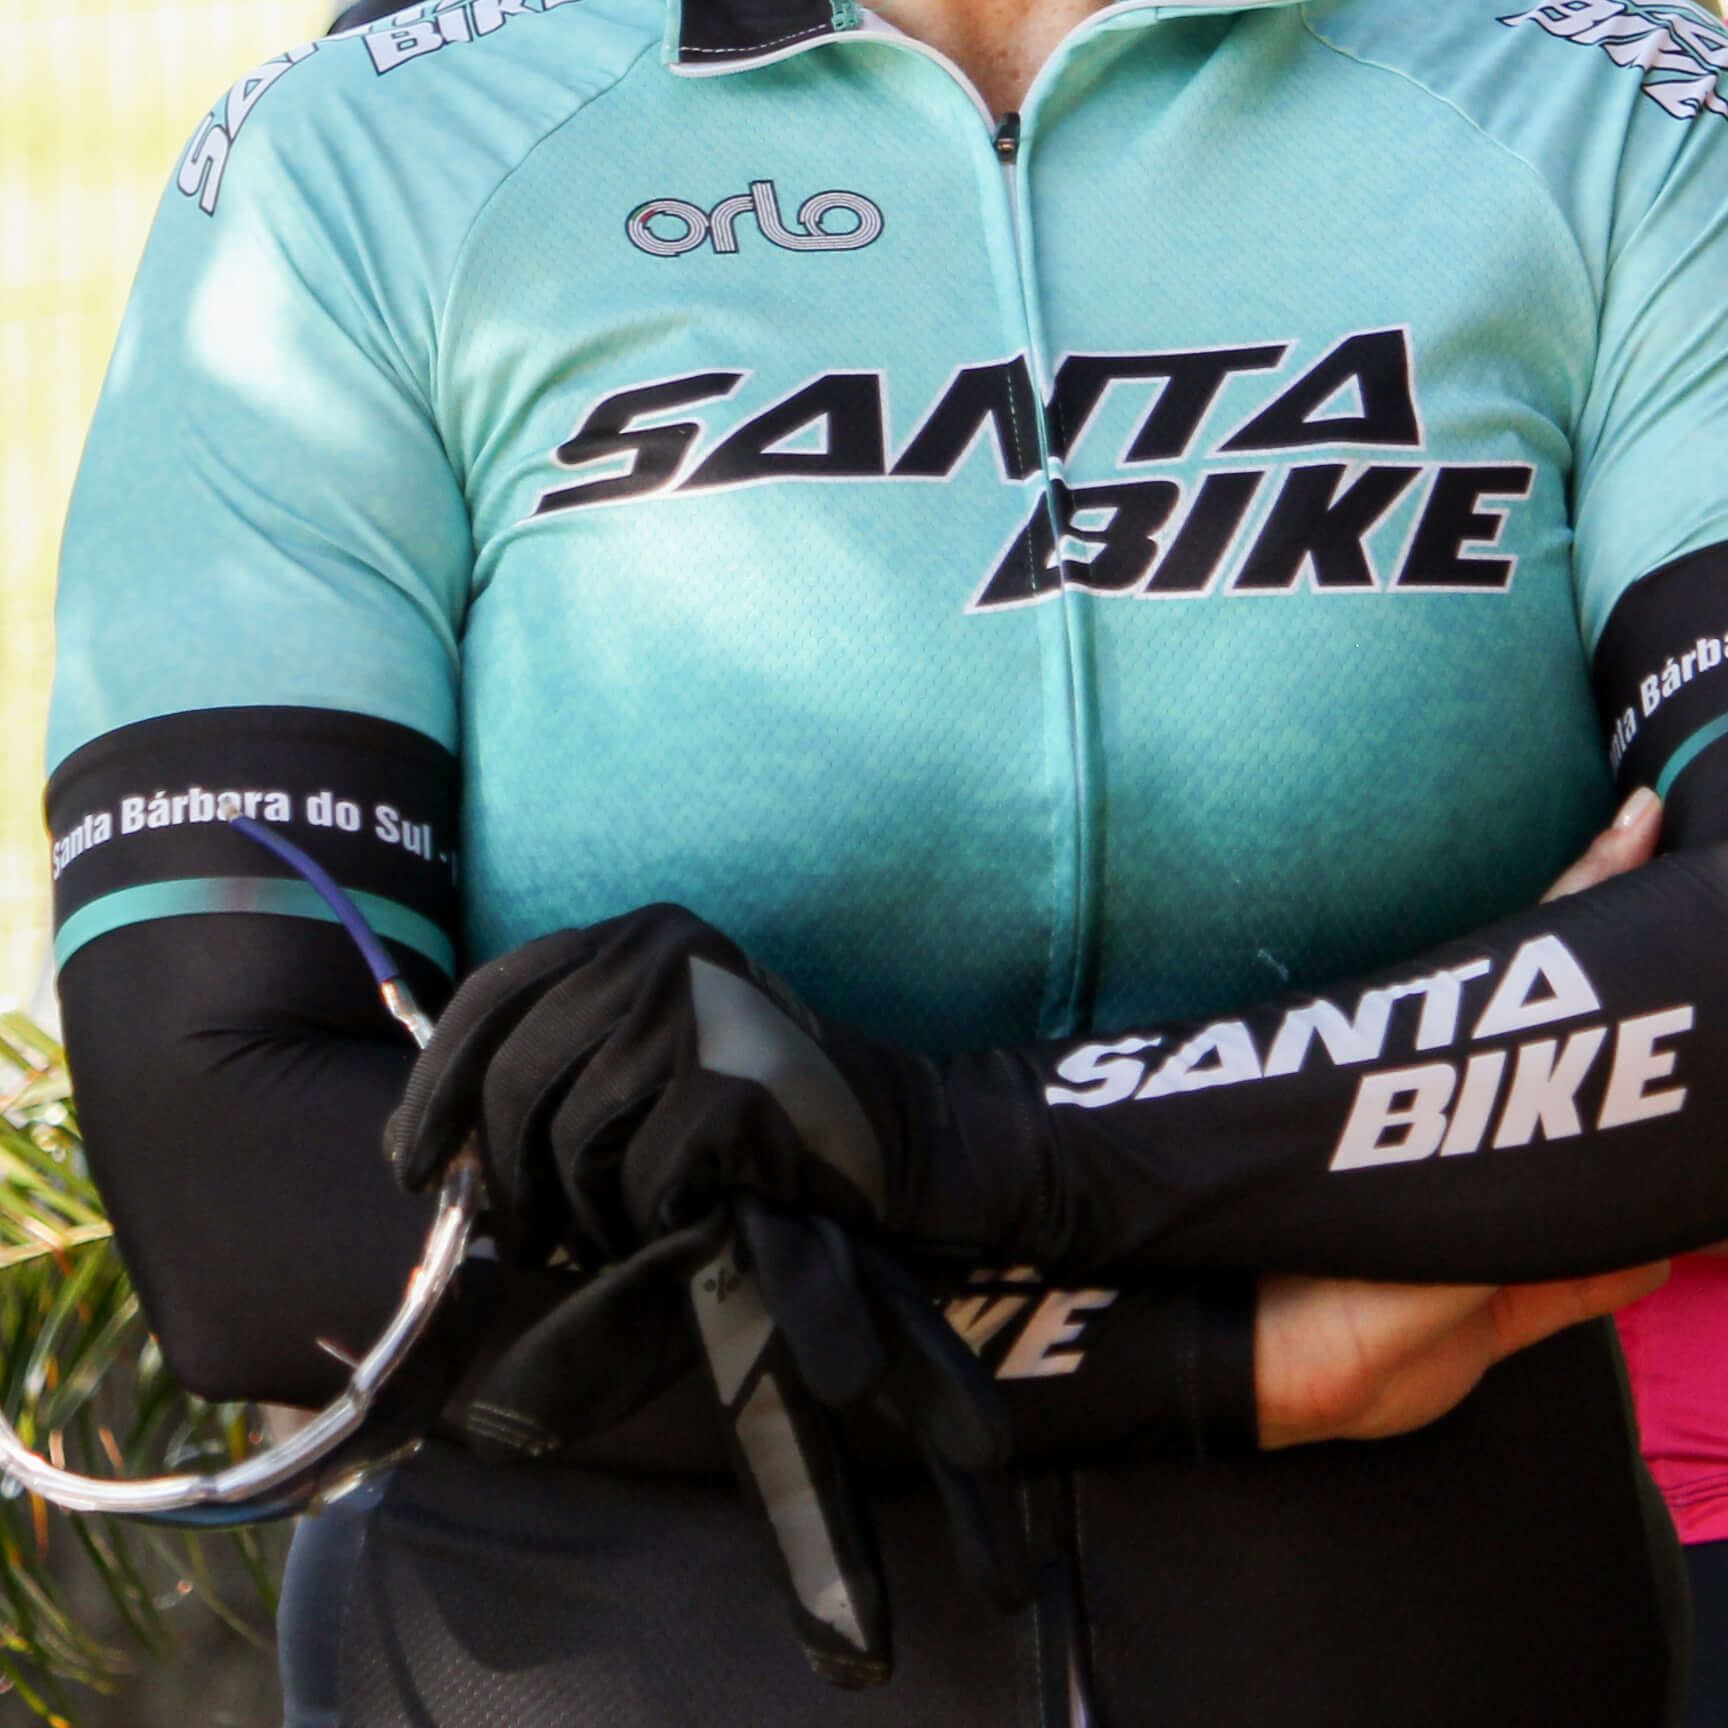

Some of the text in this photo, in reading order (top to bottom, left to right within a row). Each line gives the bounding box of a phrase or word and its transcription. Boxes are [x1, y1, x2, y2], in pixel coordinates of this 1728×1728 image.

[625, 179, 886, 258] orlo
[514, 324, 1426, 522] SANTA
[964, 461, 1537, 614] BIKE
[120, 786, 292, 836] Bárbara
[306, 790, 361, 833] do
[374, 804, 433, 862] Sul
[1043, 933, 1603, 1109] SANTA
[1328, 1004, 1695, 1173] BIKE
